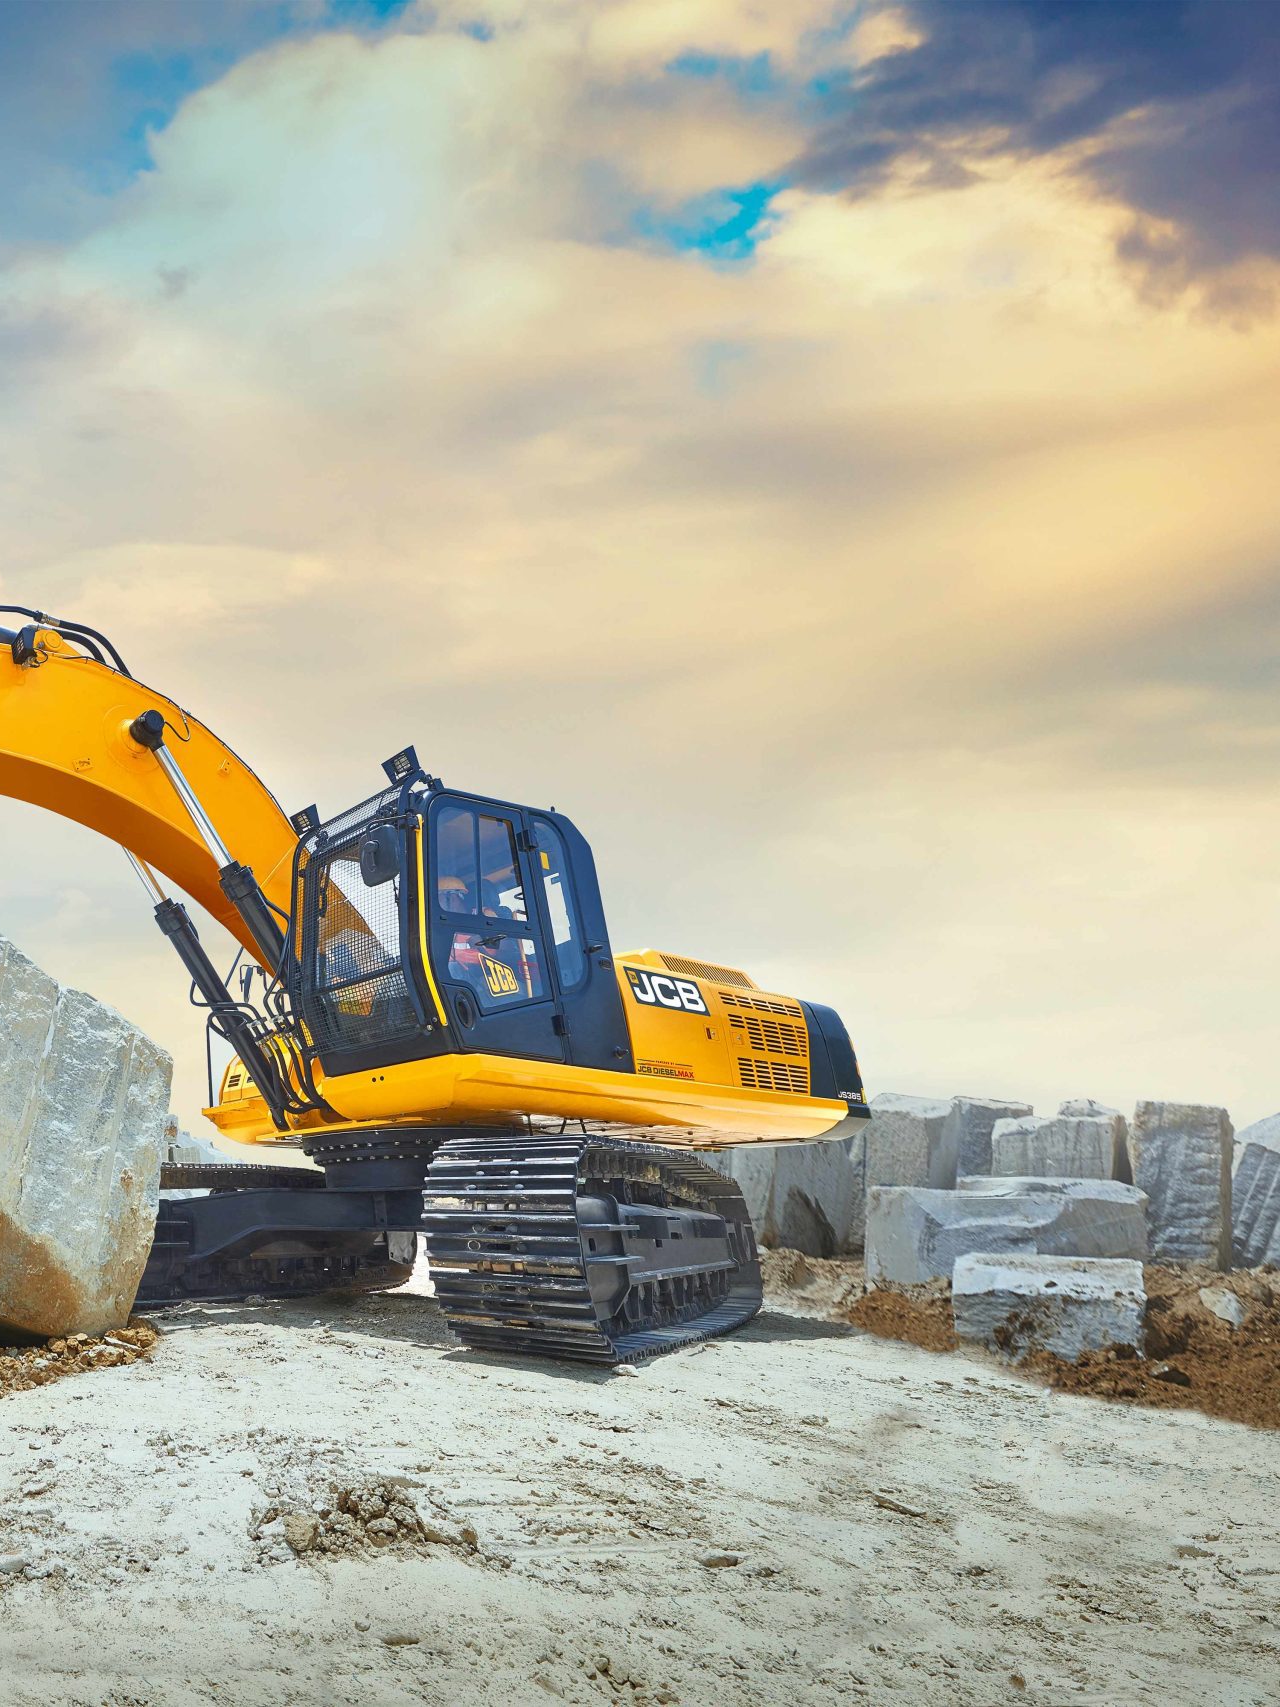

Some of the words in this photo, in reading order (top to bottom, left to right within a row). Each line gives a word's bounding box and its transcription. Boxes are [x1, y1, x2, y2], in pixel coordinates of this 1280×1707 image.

[485, 958, 517, 993] JCB
[633, 973, 706, 1012] JCB
[838, 1091, 861, 1100] JS385
